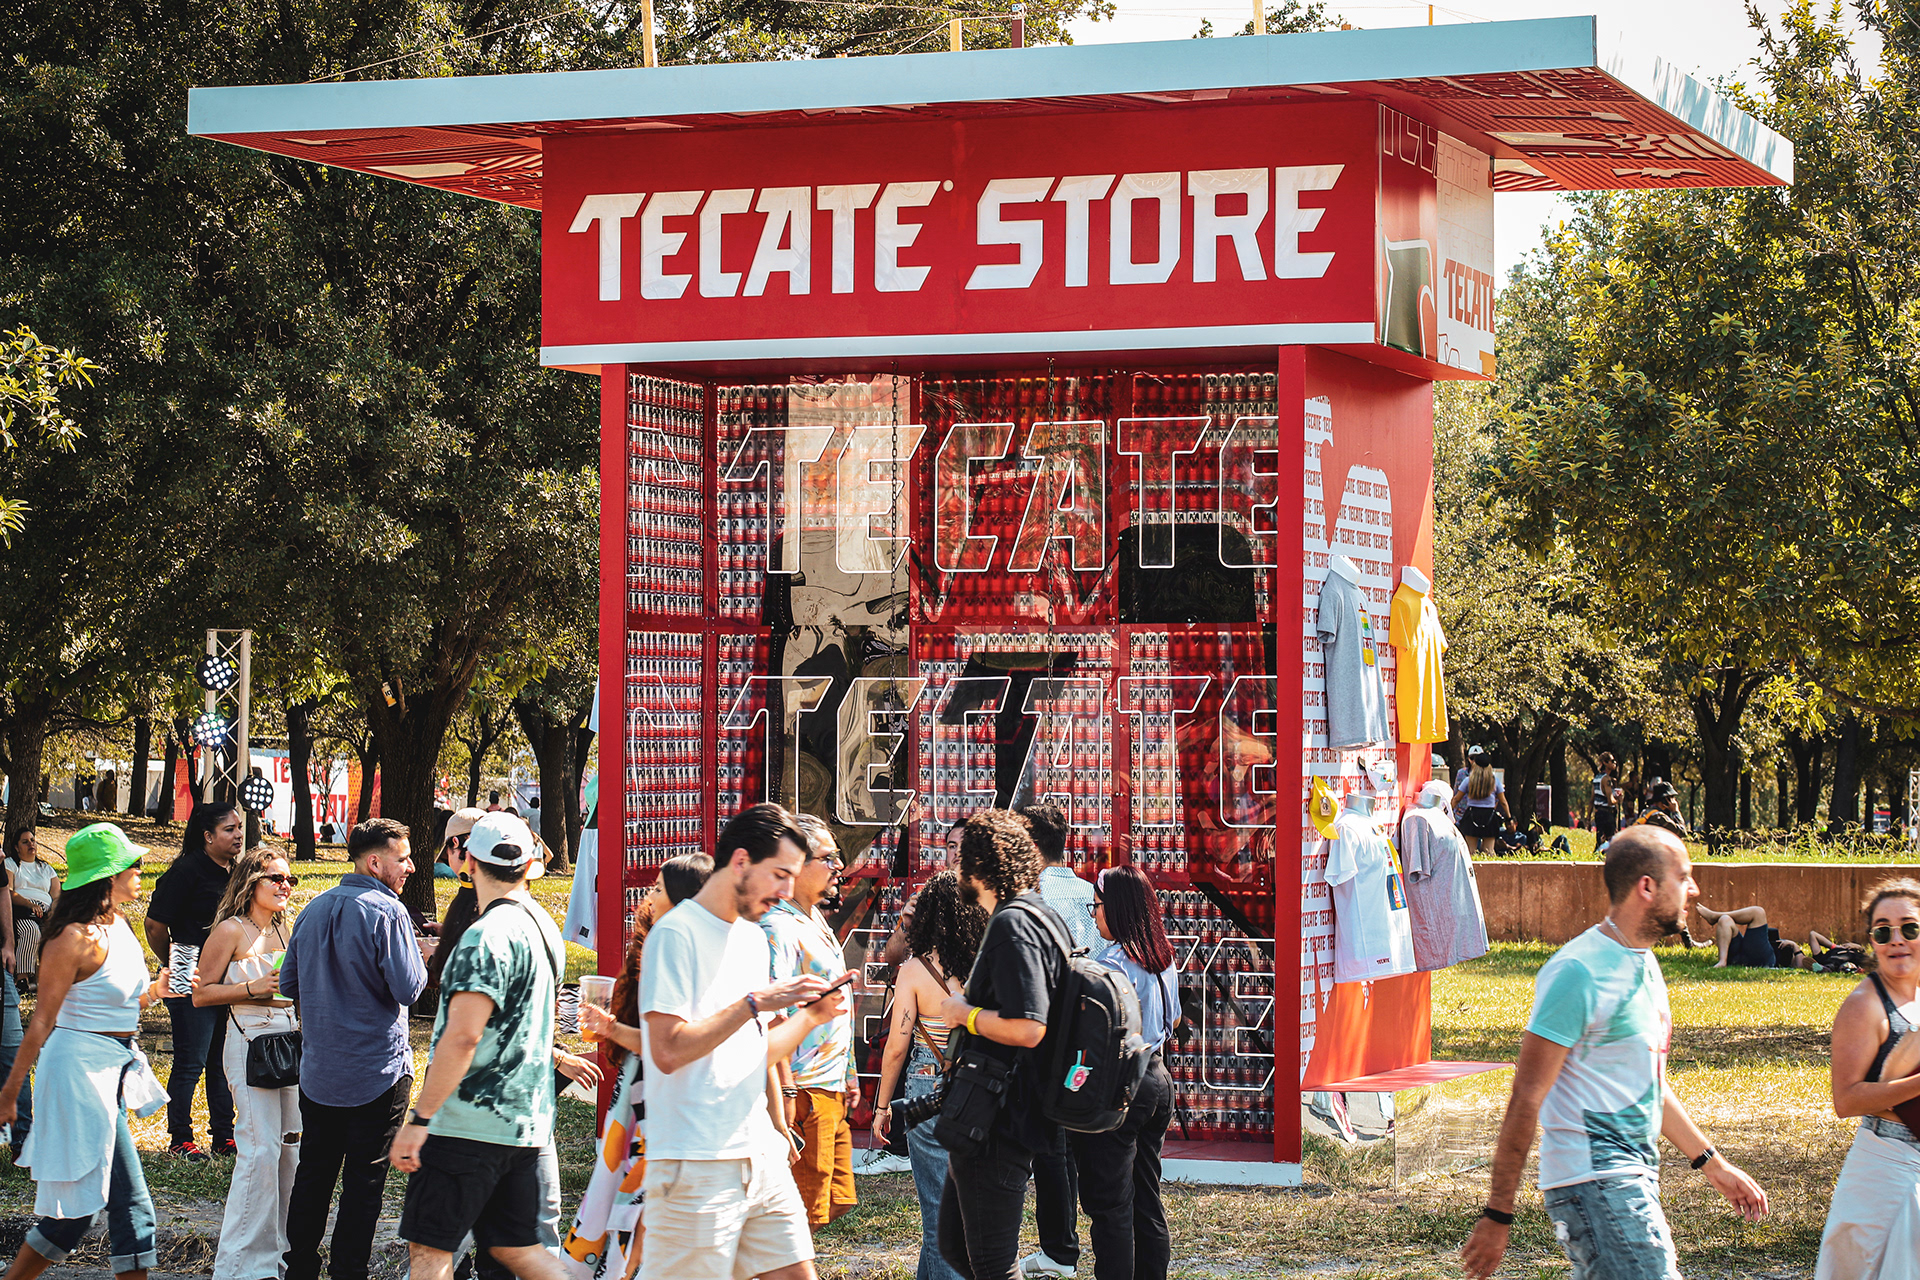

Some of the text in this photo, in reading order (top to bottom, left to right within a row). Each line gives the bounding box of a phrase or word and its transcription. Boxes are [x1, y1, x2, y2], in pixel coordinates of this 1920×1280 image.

[568, 164, 1345, 301] TECATE STORE
[725, 416, 1279, 574] TECATE
[723, 675, 1278, 828] TECATE
